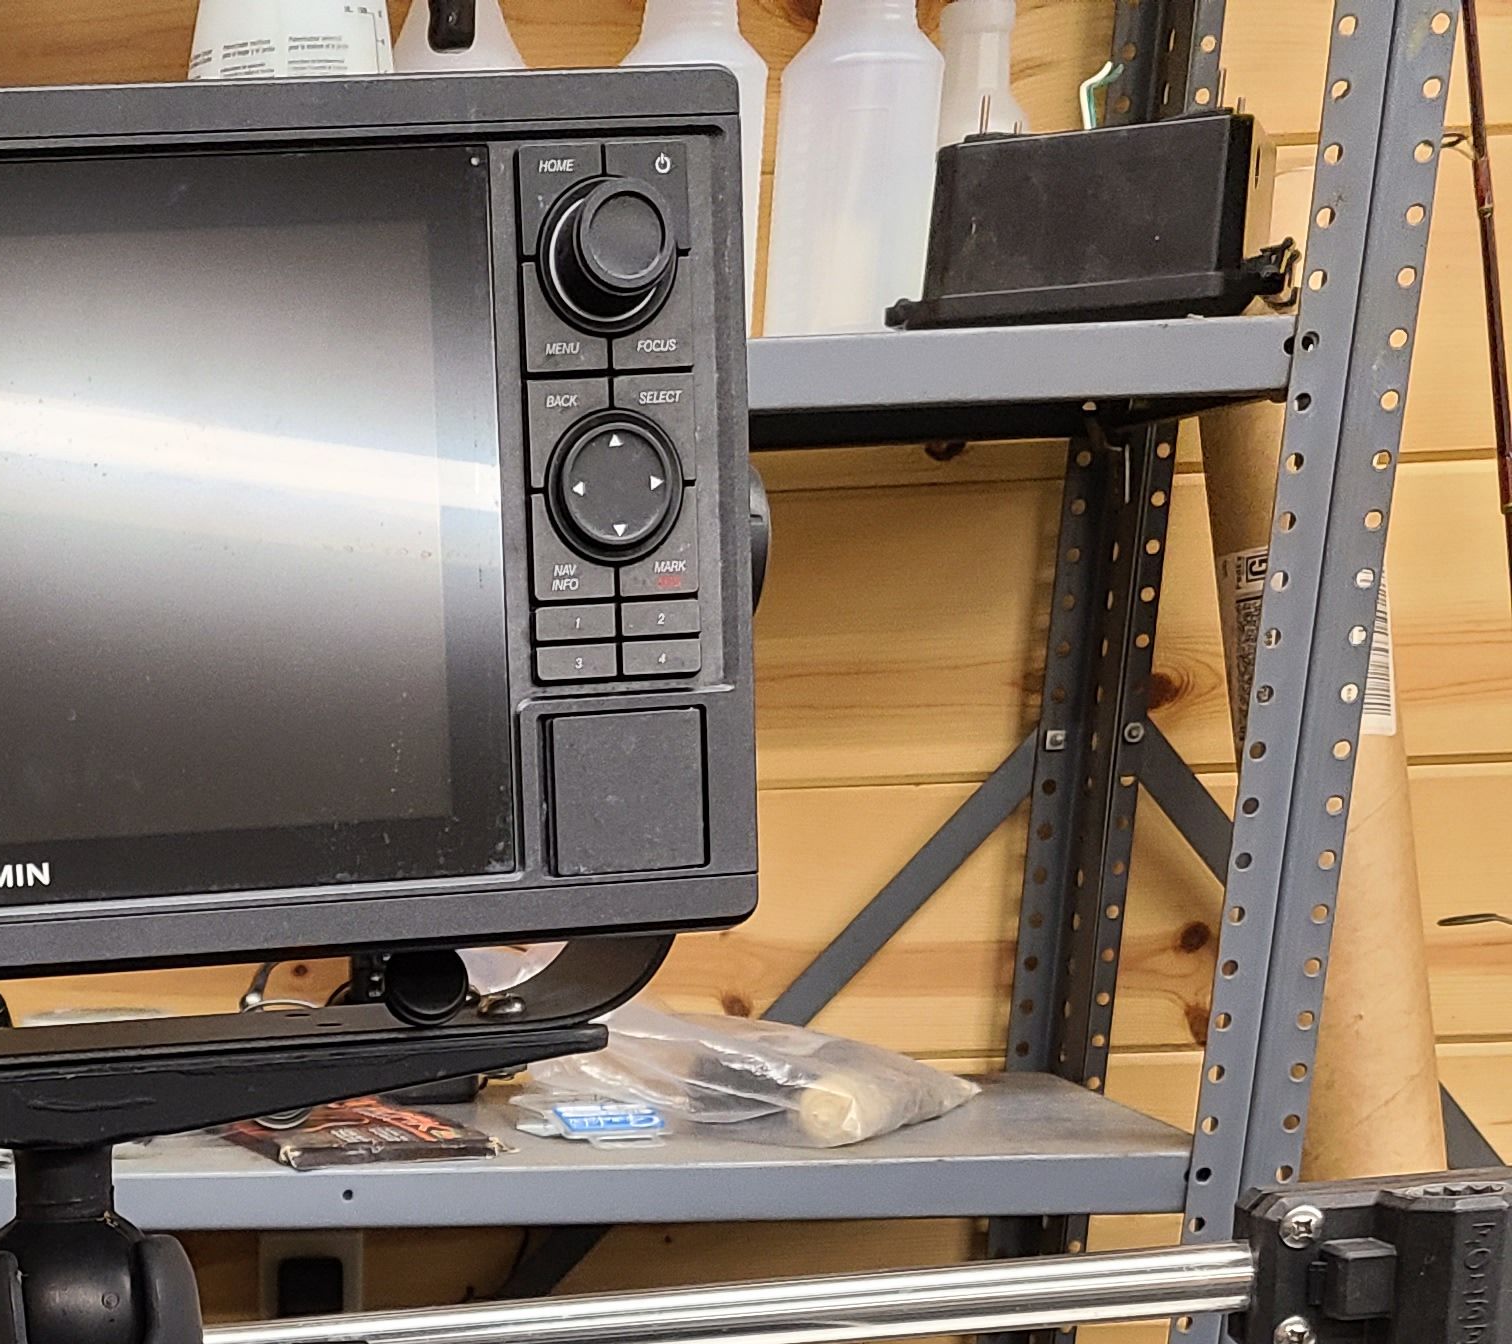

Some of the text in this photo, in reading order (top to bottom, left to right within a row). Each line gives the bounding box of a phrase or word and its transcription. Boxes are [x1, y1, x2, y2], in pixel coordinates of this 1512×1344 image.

[539, 159, 575, 172] HOME
[546, 341, 580, 355] MENU
[637, 339, 677, 353] FOCUS
[546, 394, 578, 408] BACK
[639, 390, 682, 405] SELECT
[553, 563, 577, 577] NAV
[654, 560, 686, 575] MARK
[551, 577, 579, 591] INFO
[574, 616, 581, 629] 1
[657, 612, 665, 625] 2
[575, 657, 583, 669] 3
[658, 652, 667, 665] 4
